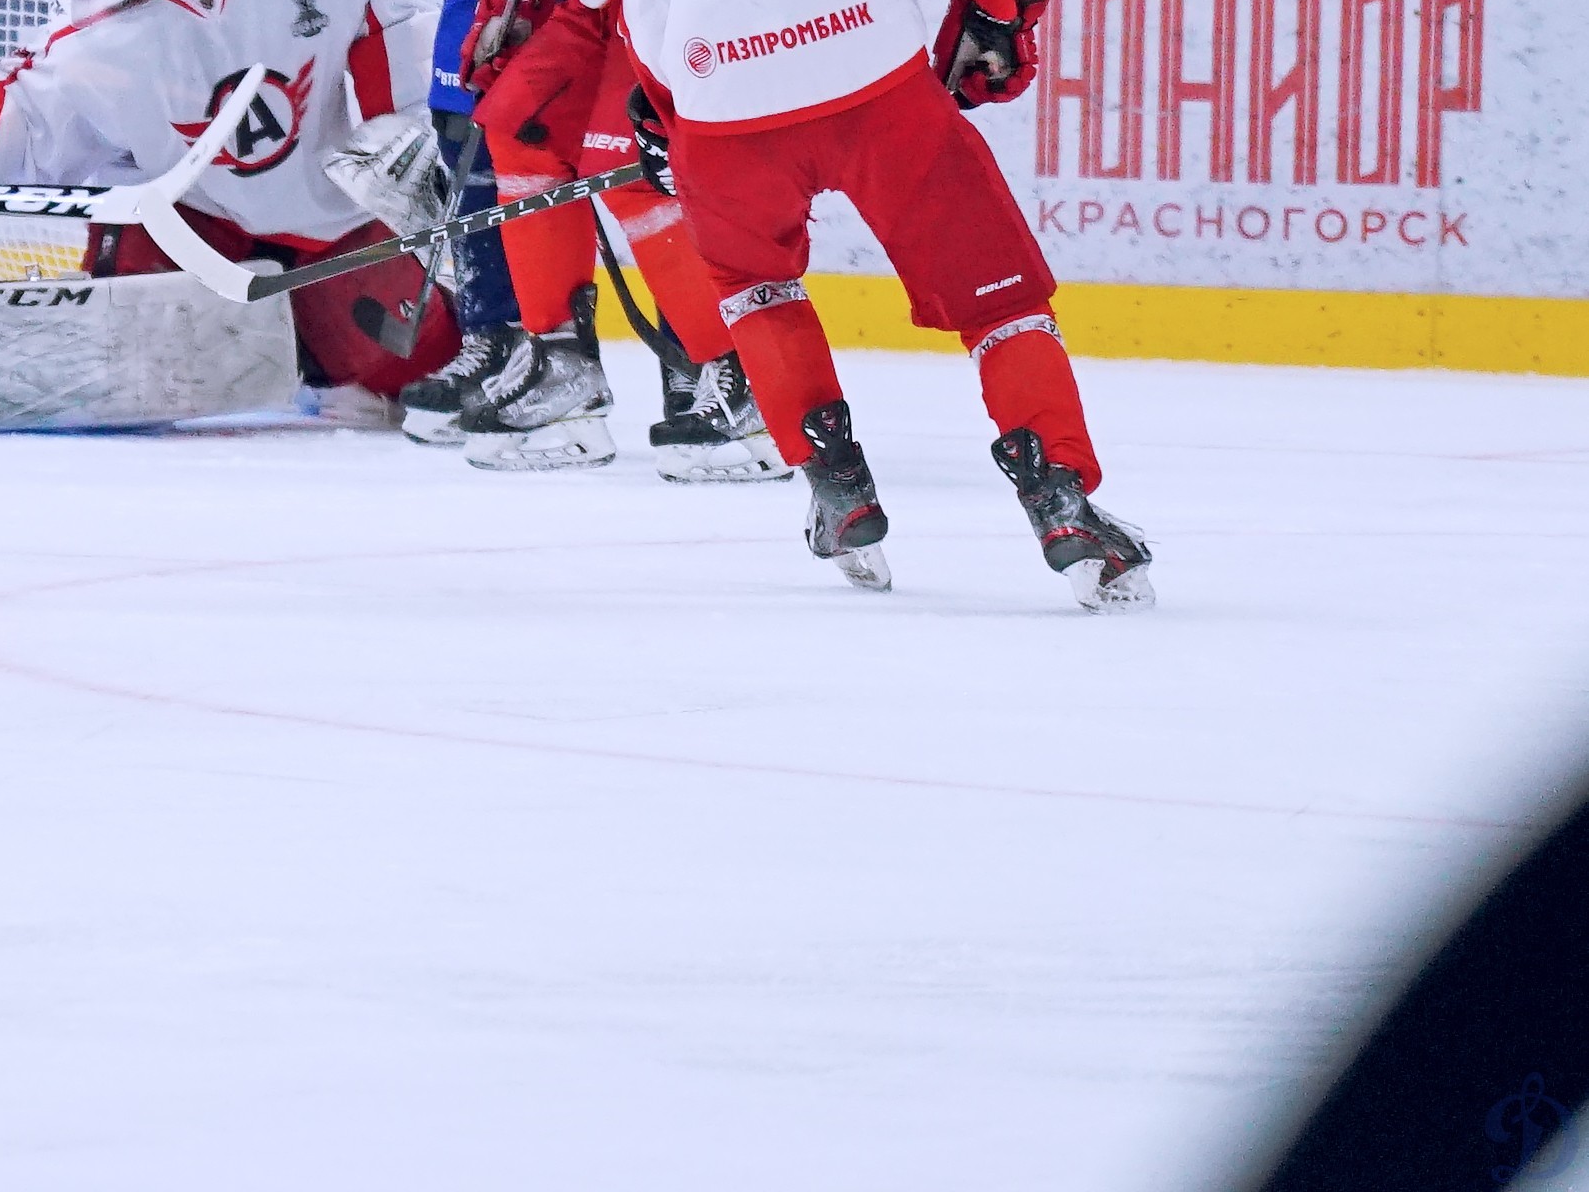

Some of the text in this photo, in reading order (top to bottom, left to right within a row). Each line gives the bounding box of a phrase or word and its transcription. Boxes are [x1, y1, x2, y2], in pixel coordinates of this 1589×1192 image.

[715, 1, 875, 65] ГАЗПРОМБАНК
[582, 131, 633, 155] UER
[399, 171, 617, 254] CATALYST
[1036, 200, 1470, 248] КРАСНОГОРСК
[975, 274, 1023, 297] BAUER
